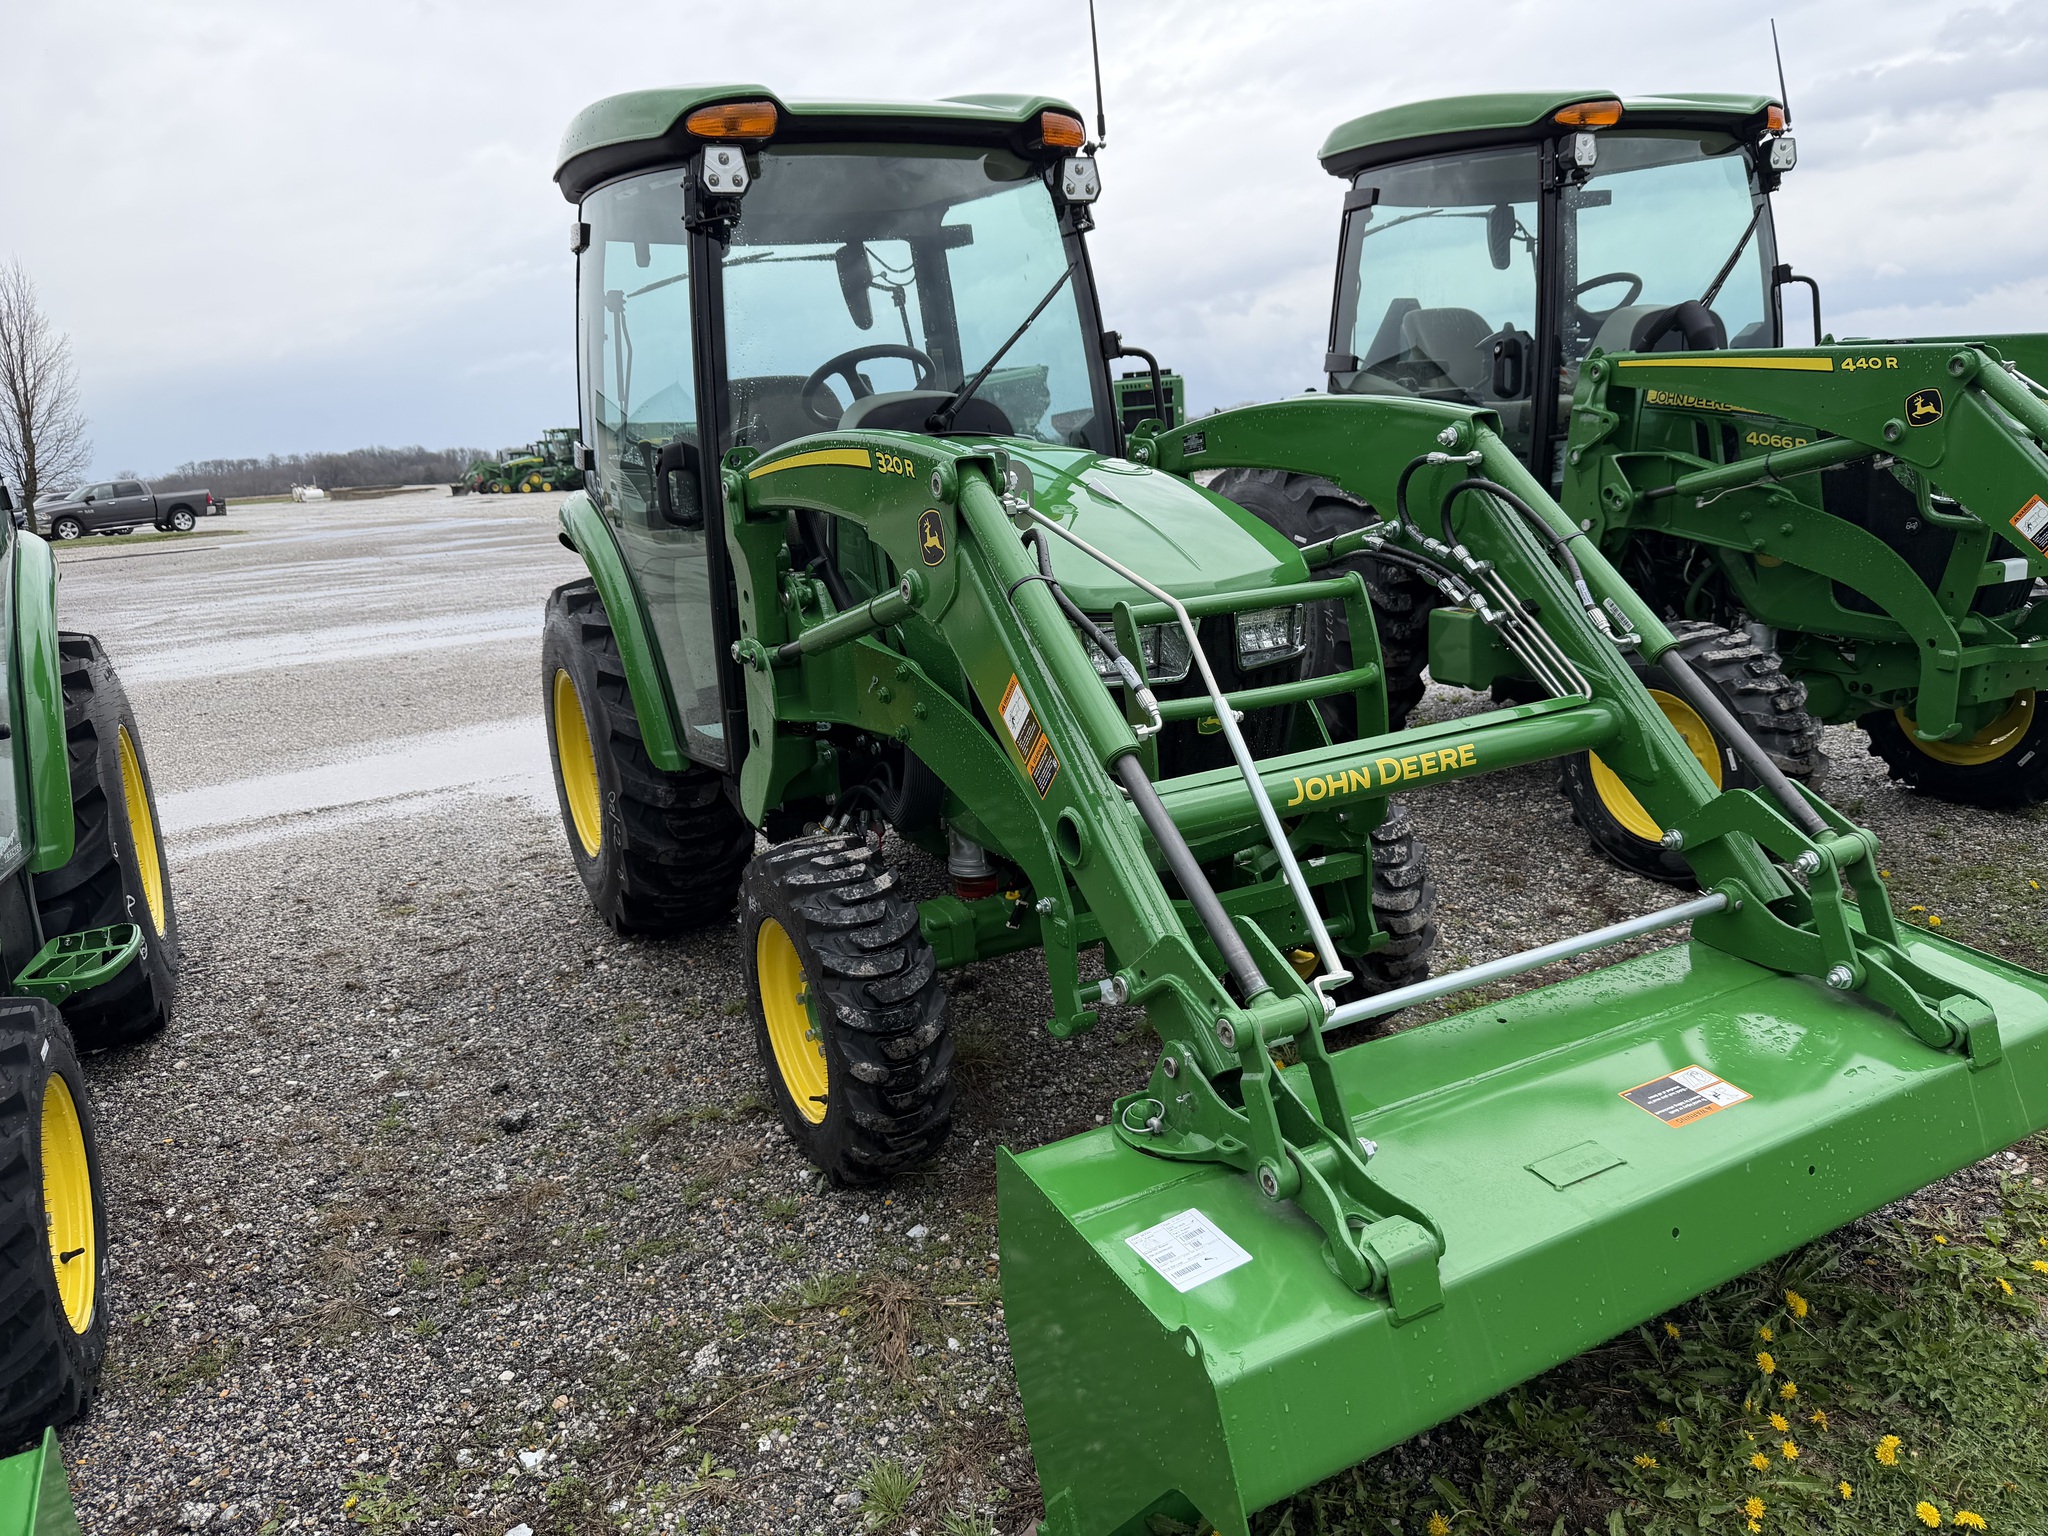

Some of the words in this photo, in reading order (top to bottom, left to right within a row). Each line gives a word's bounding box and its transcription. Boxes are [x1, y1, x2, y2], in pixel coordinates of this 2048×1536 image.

[1841, 357, 1882, 371] 440
[1884, 357, 1899, 369] R
[1651, 391, 1684, 404] JOHN
[1746, 431, 1793, 449] 4066
[875, 451, 903, 475] 320
[904, 459, 916, 479] R
[1287, 766, 1371, 807] JOHN
[1375, 743, 1477, 785] DEERE
